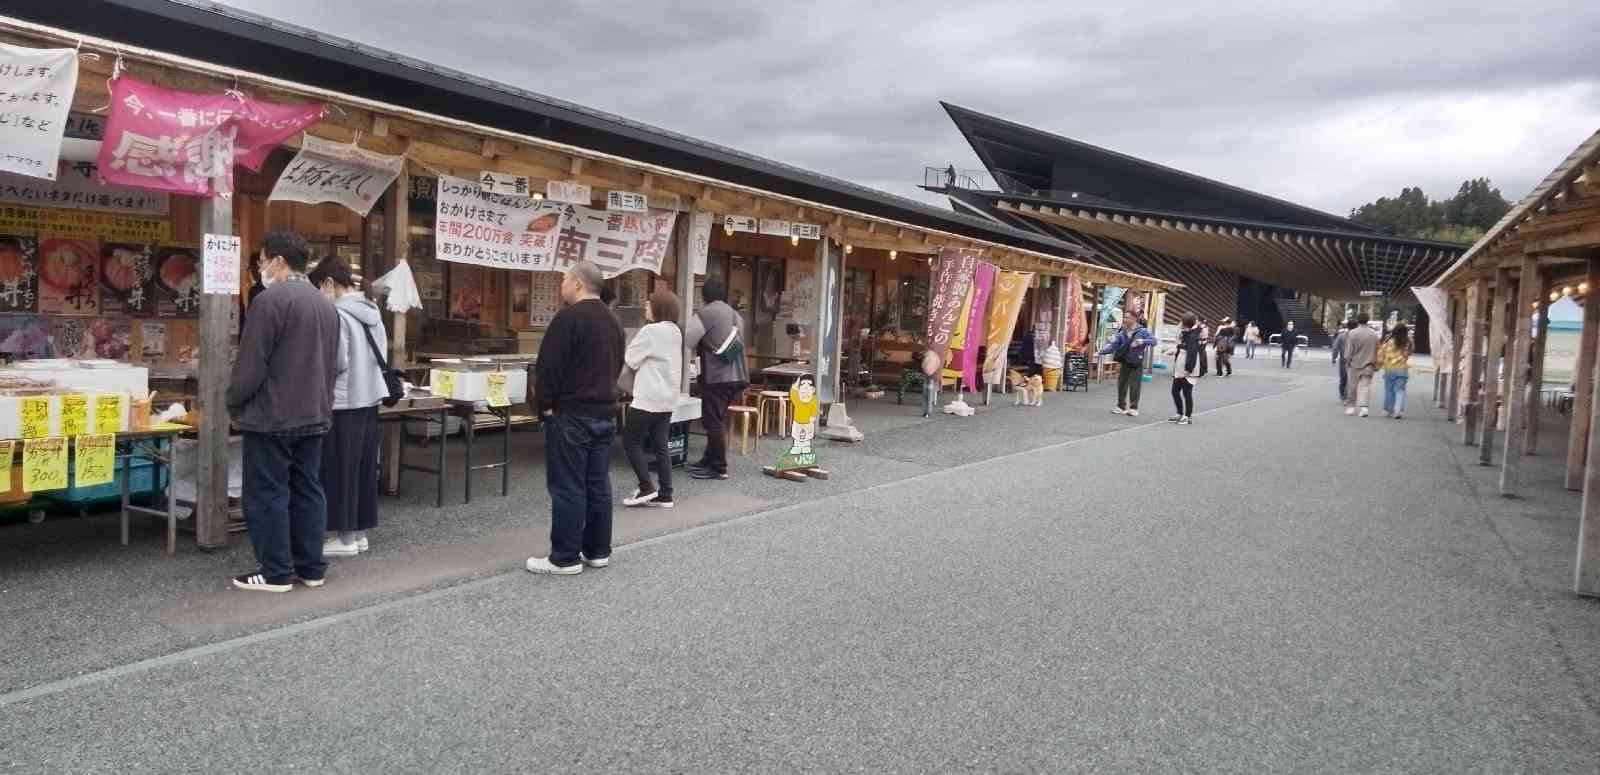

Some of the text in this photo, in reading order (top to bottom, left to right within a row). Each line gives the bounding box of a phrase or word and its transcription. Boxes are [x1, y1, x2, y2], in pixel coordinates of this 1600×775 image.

[440, 200, 508, 225] おかげさまで
